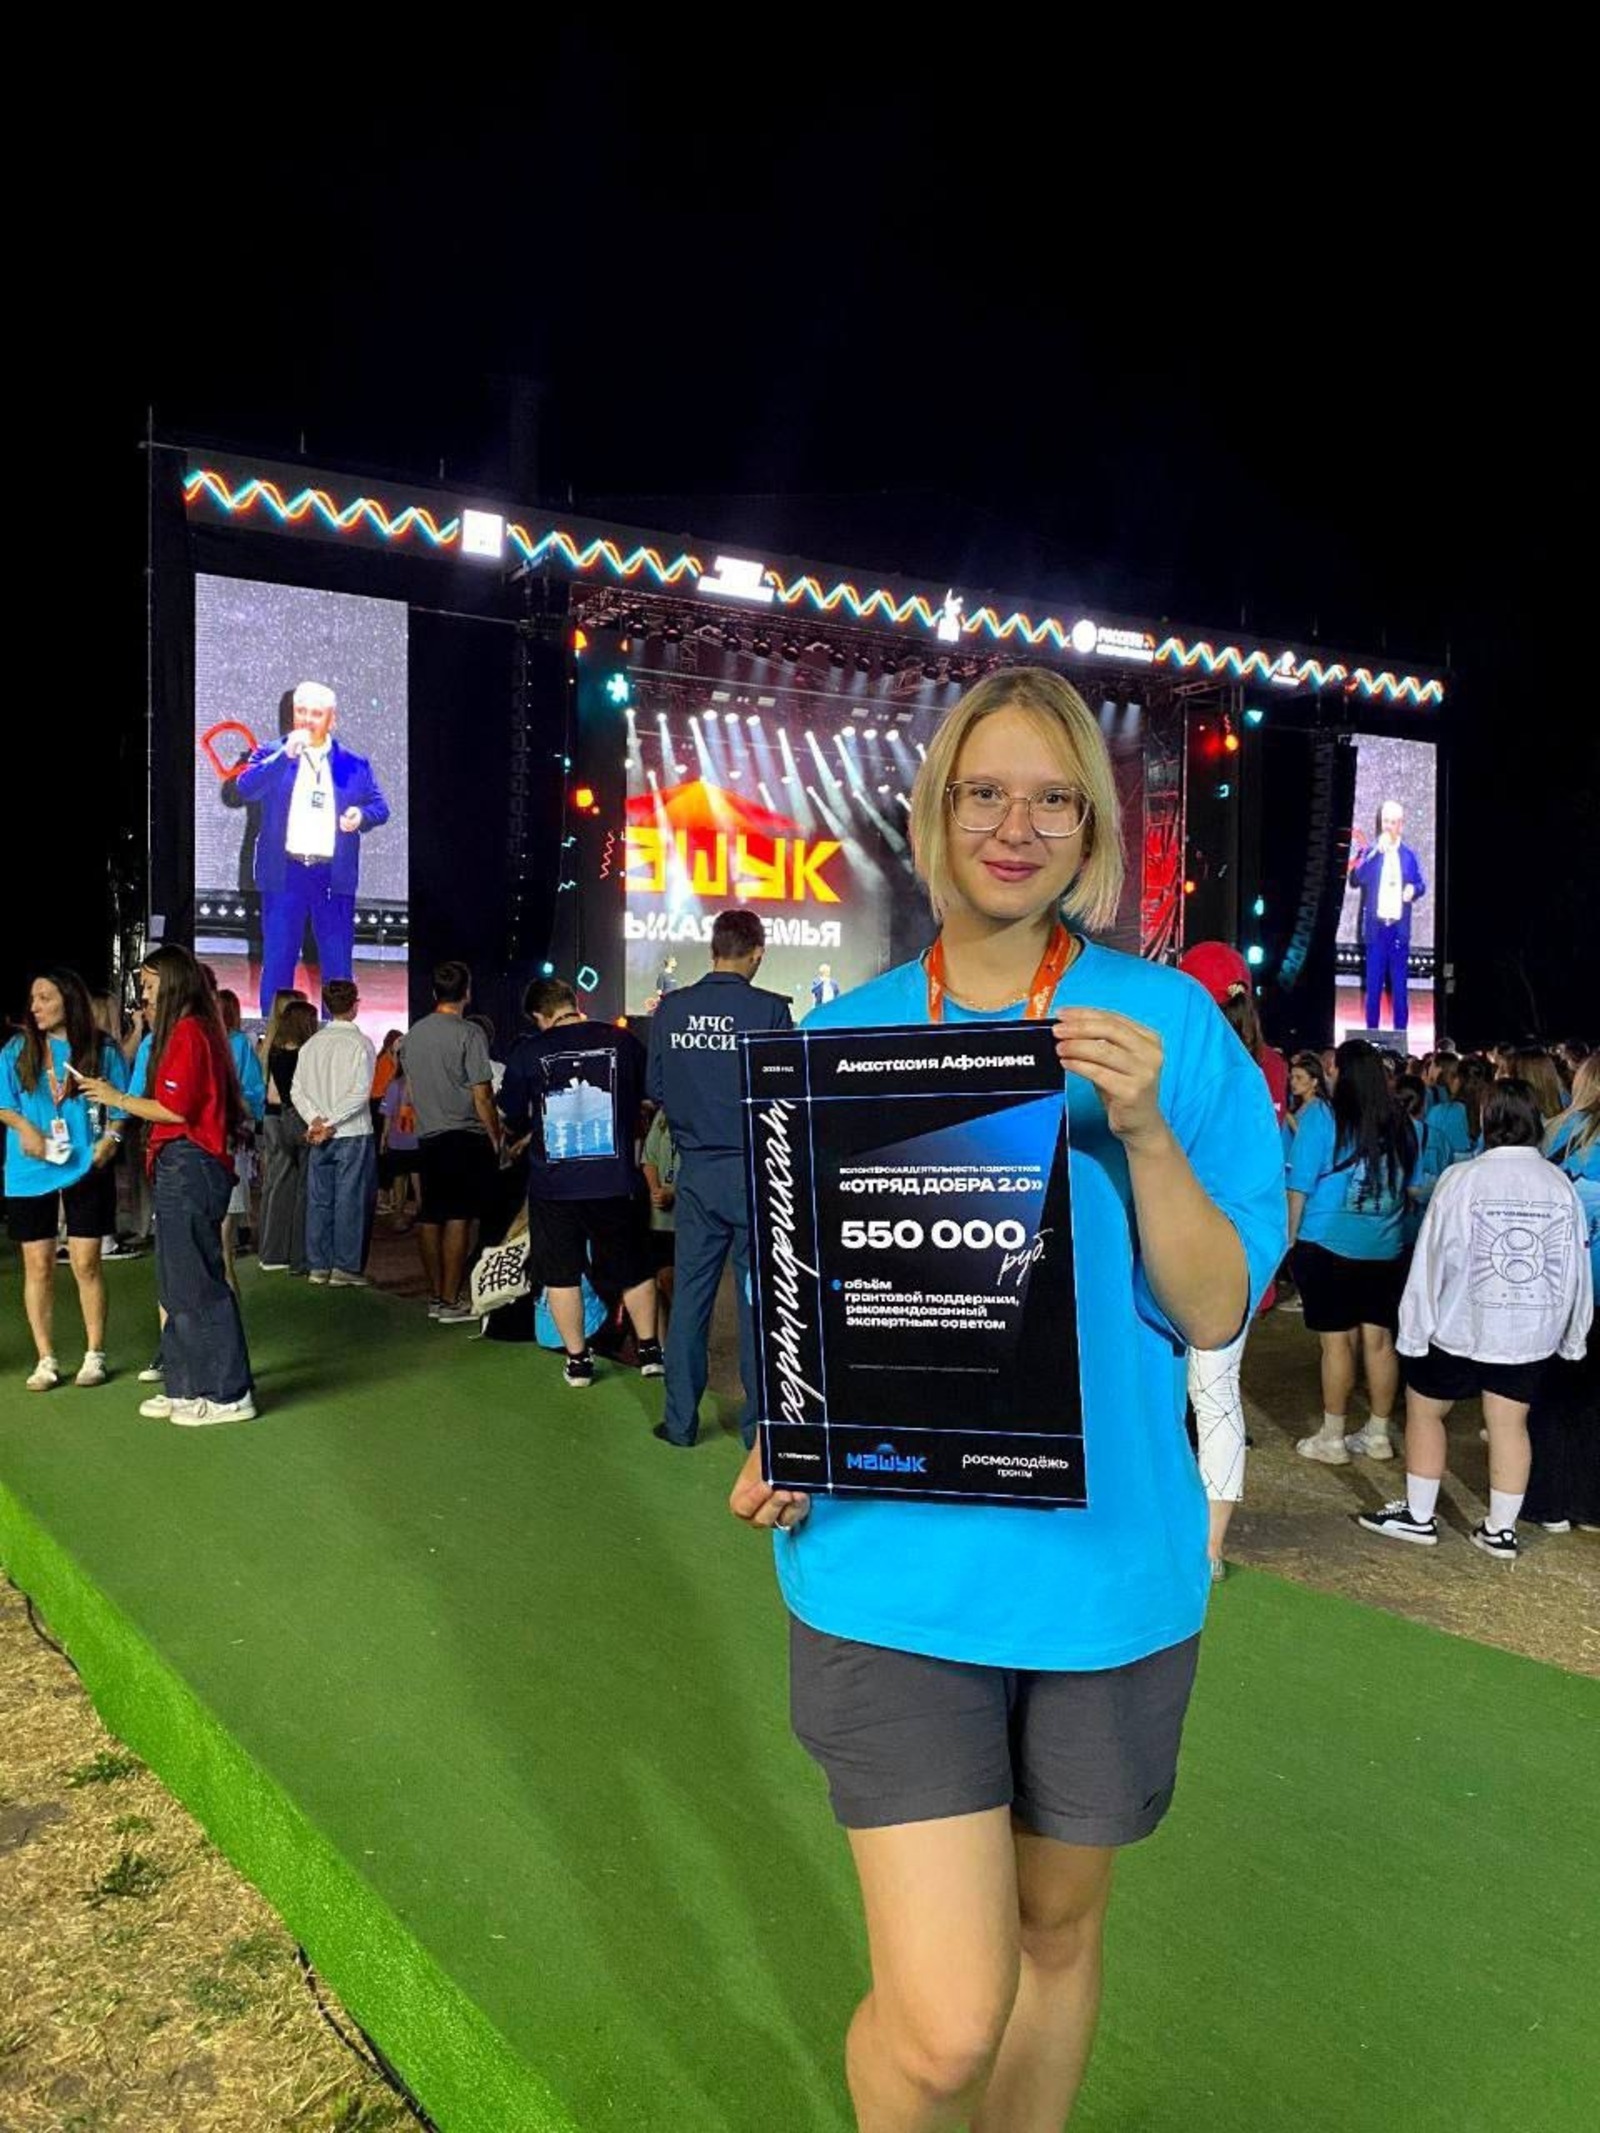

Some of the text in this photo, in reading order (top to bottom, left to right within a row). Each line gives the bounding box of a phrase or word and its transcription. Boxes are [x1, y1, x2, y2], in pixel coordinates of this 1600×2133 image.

[686, 1014, 734, 1033] МЧС
[670, 1032, 739, 1051] РОССИ
[836, 1053, 1035, 1073] Анастасия Афонина
[839, 1178, 1043, 1195] «ОТРЯД ДОБРА 2.0»
[840, 1219, 1026, 1250] 550 000
[996, 1227, 1055, 1287] руб.
[844, 1278, 893, 1290] объём
[844, 1291, 1020, 1306] грантовой поддержки,
[845, 1305, 988, 1317] рекомендованный
[846, 1317, 1006, 1330] экспертным советом
[962, 1453, 1069, 1470] росмолодёжь
